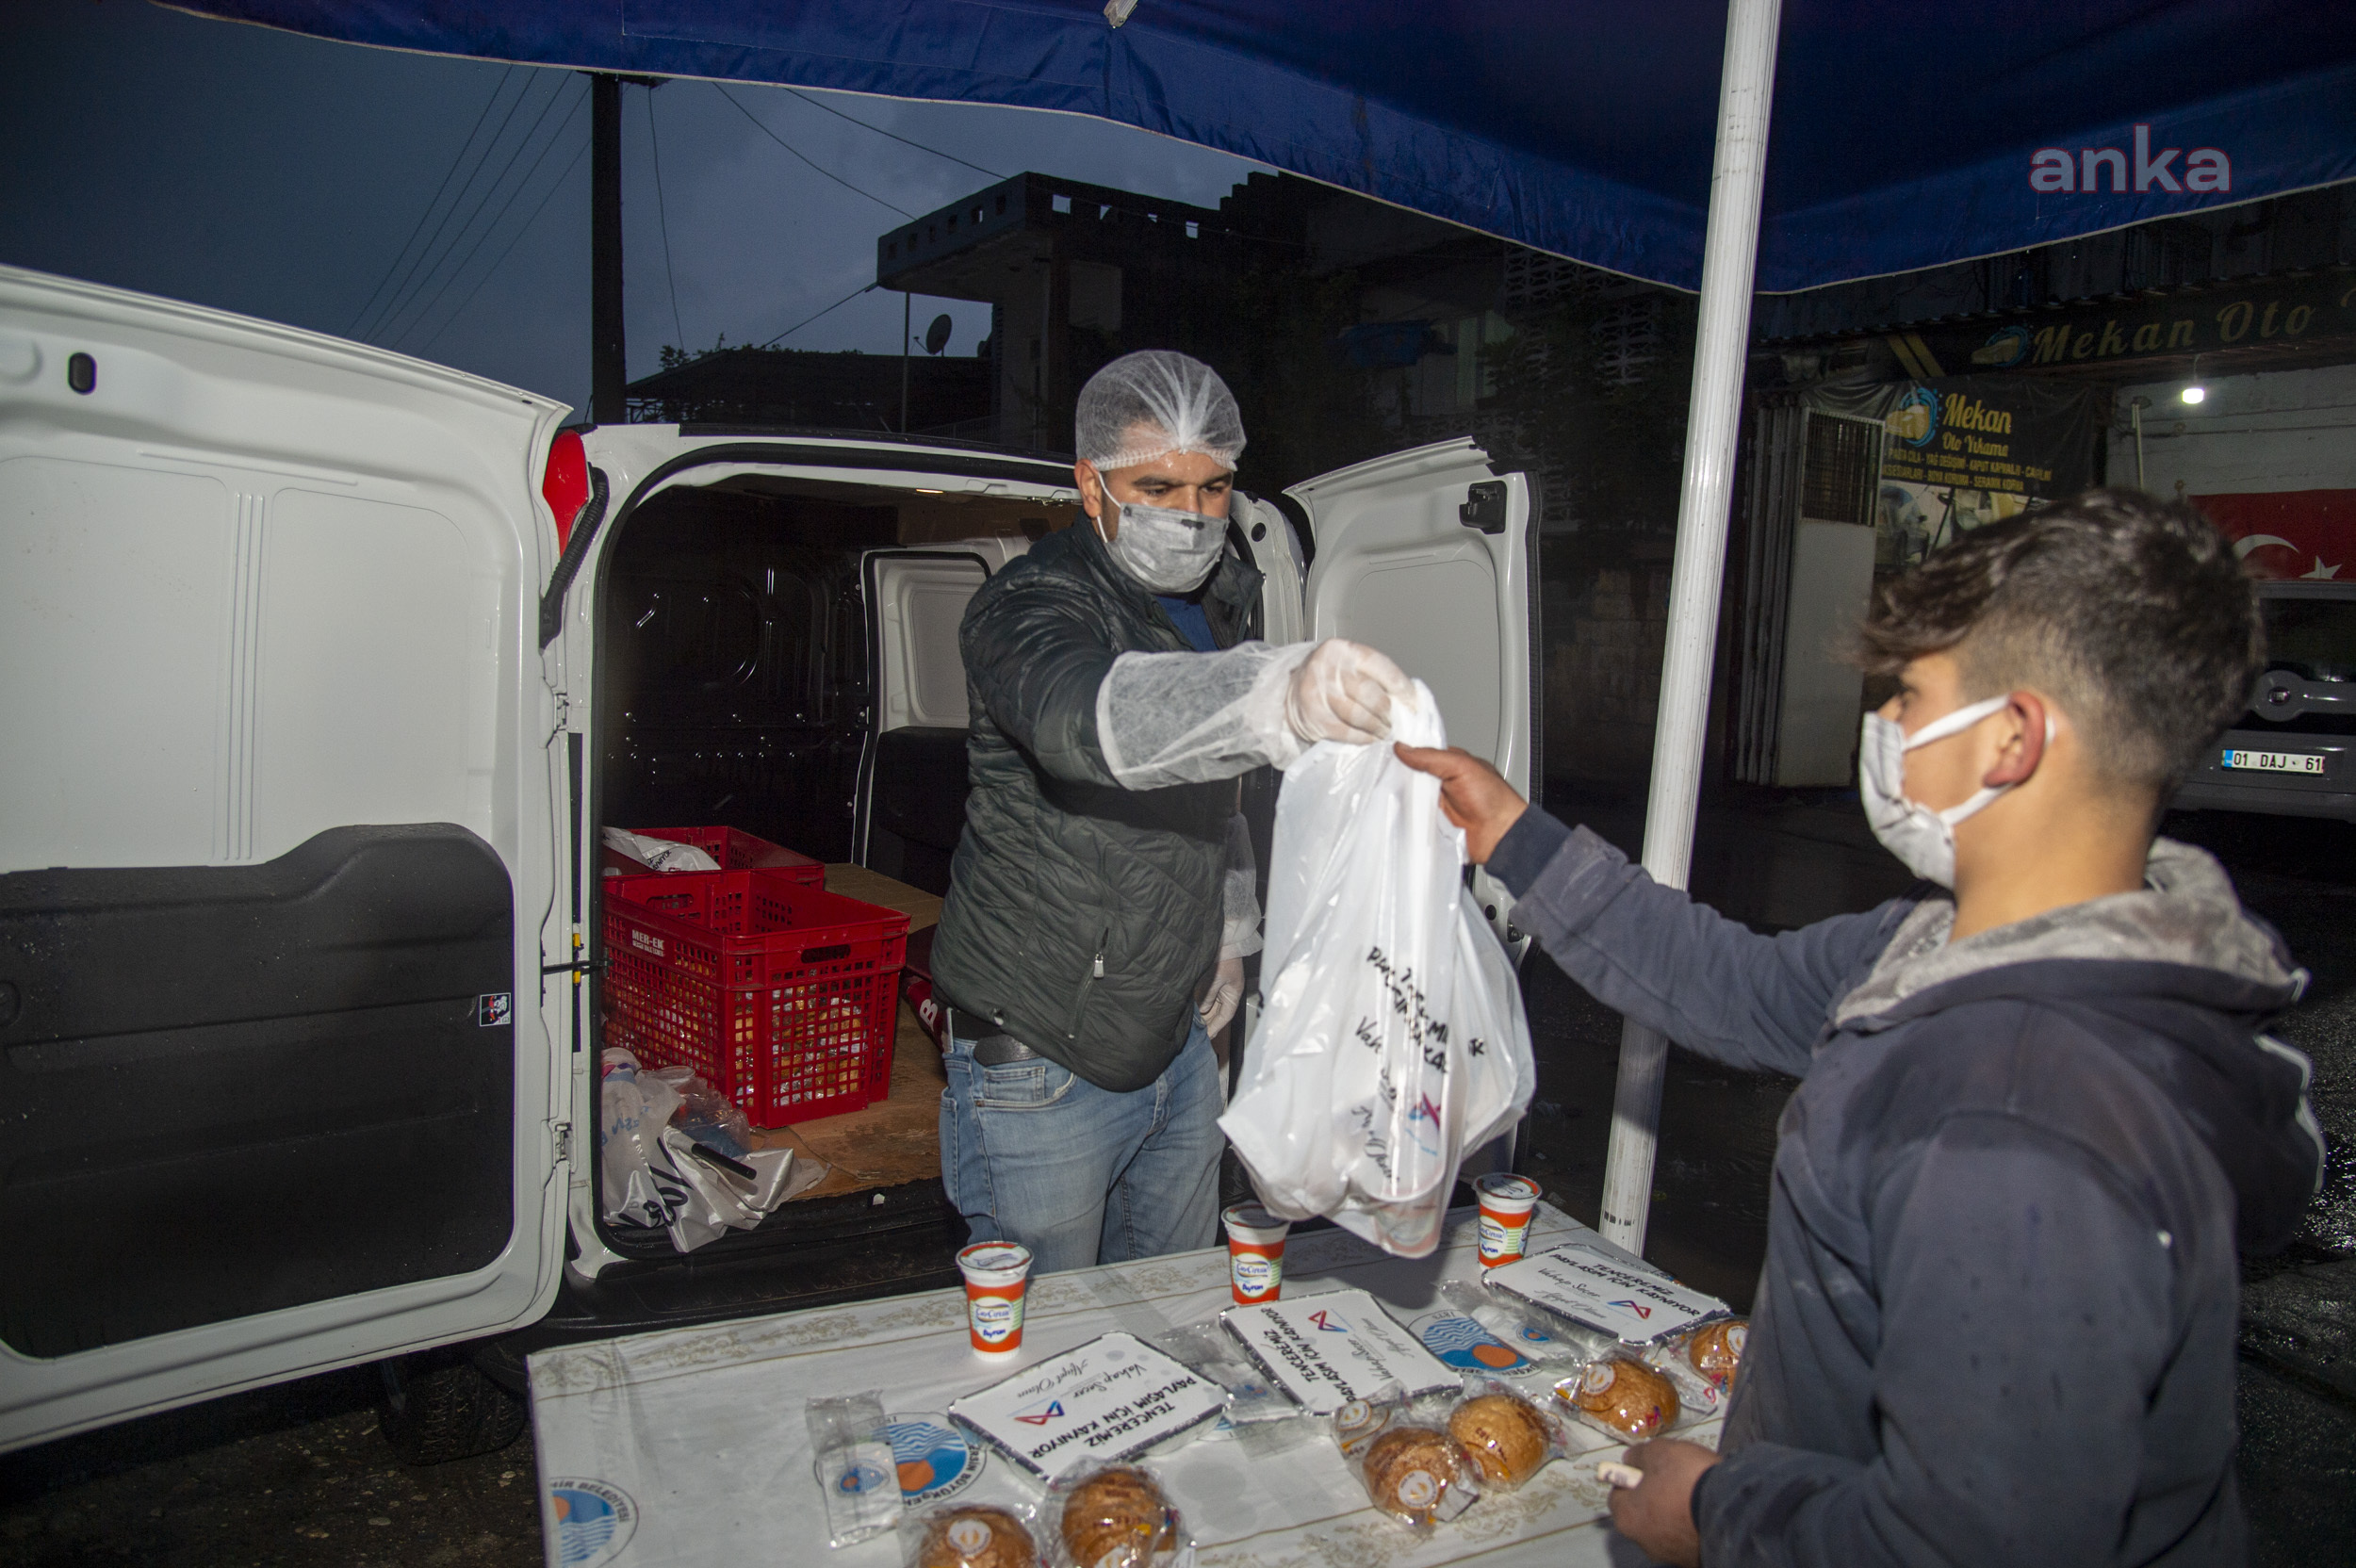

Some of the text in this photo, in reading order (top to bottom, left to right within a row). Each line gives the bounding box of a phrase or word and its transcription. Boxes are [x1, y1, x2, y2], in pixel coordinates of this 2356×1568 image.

[2031, 300, 2316, 364] Mekan Oto
[1942, 393, 2012, 436] Mekan
[1942, 431, 1962, 451] Oto
[2233, 752, 2321, 771] 01 DAJ 61
[631, 929, 664, 951] MER-EK
[1548, 1253, 1608, 1280] PAYLAŞIM
[1635, 1286, 1701, 1317] KAYNIYOR
[1594, 1263, 1675, 1295] TENCEREMİZ
[1260, 1307, 1304, 1341] KAYNIYOR
[1264, 1328, 1320, 1382] TENCEREMİZ
[1296, 1341, 1321, 1361] İÇİN
[1098, 1363, 1147, 1386] Vahap
[1313, 1355, 1359, 1403] PAYLAŞIM
[1030, 1375, 1197, 1460] PAYLAŞIM İÇİN KAYNIYOR
[1084, 1402, 1176, 1447] TENCEREMİZ
